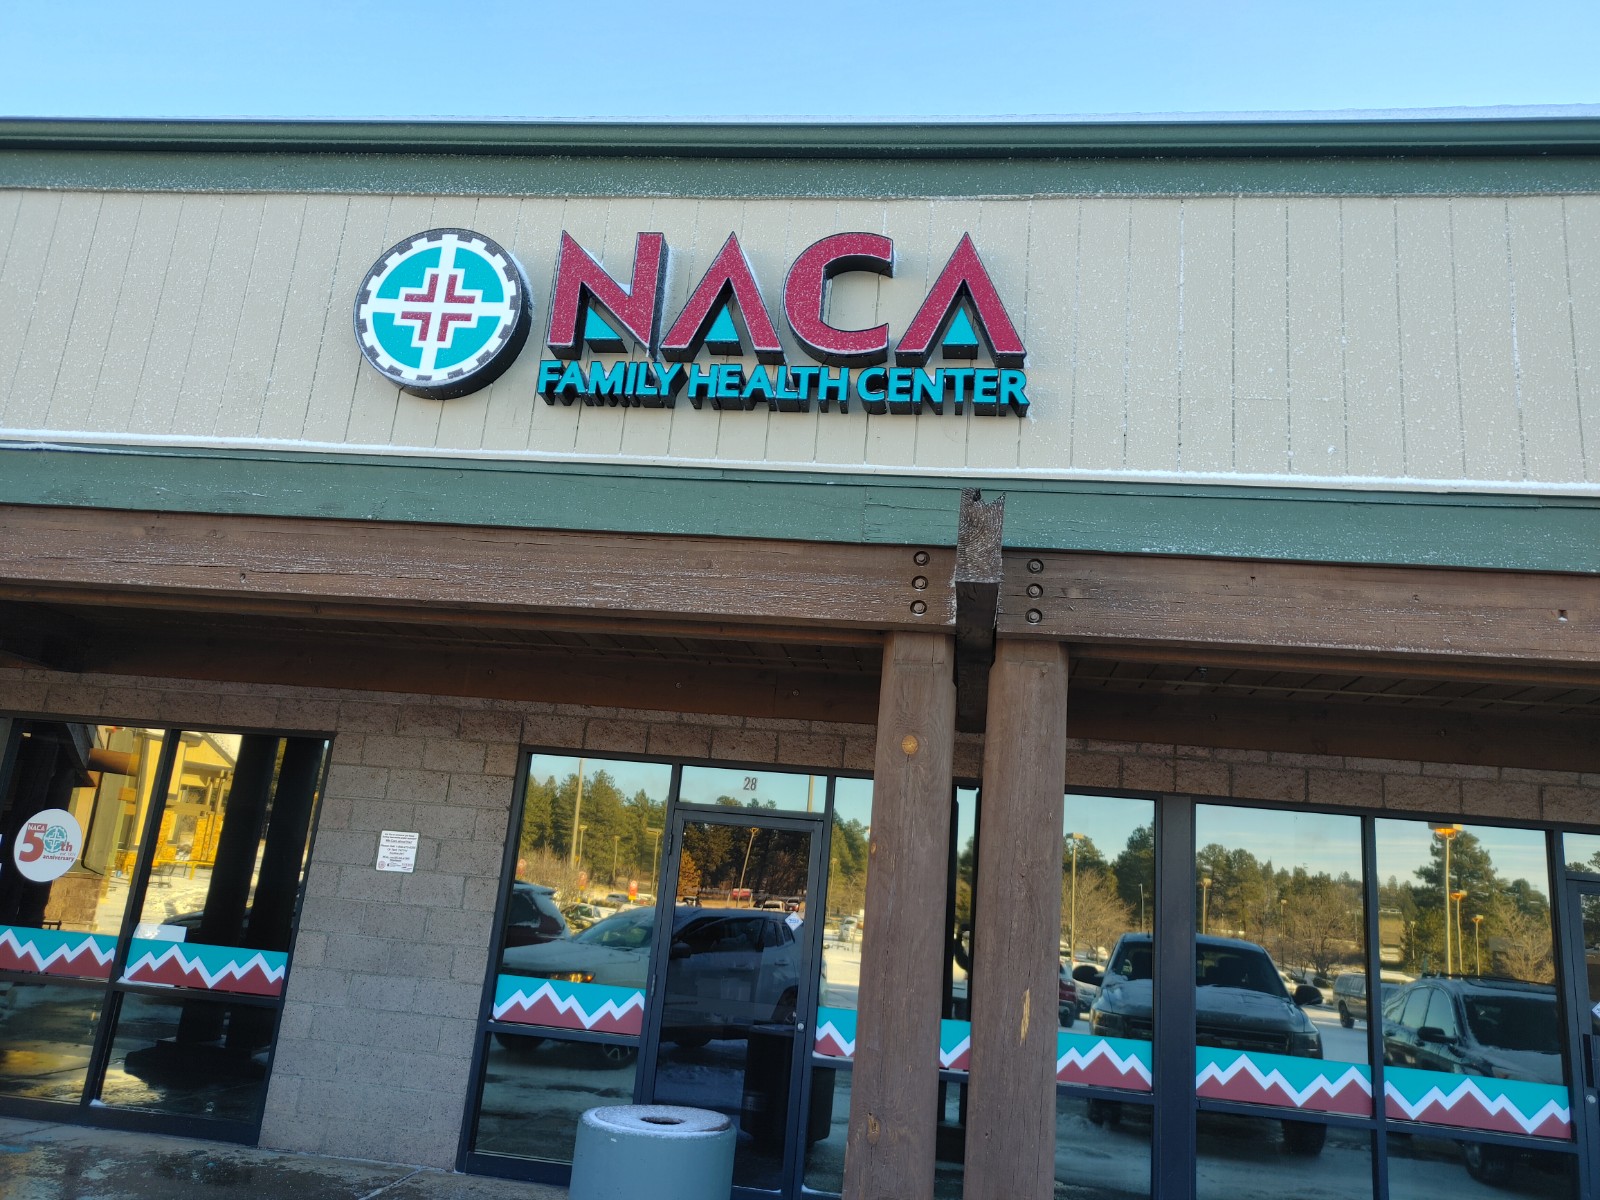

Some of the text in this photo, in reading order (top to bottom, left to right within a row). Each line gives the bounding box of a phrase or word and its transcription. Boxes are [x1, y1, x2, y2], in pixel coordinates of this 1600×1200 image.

[546, 230, 1028, 364] NACA
[537, 360, 1028, 409] FAMILY HEALTH CENTER
[743, 776, 757, 791] 28
[27, 824, 46, 832] NACA
